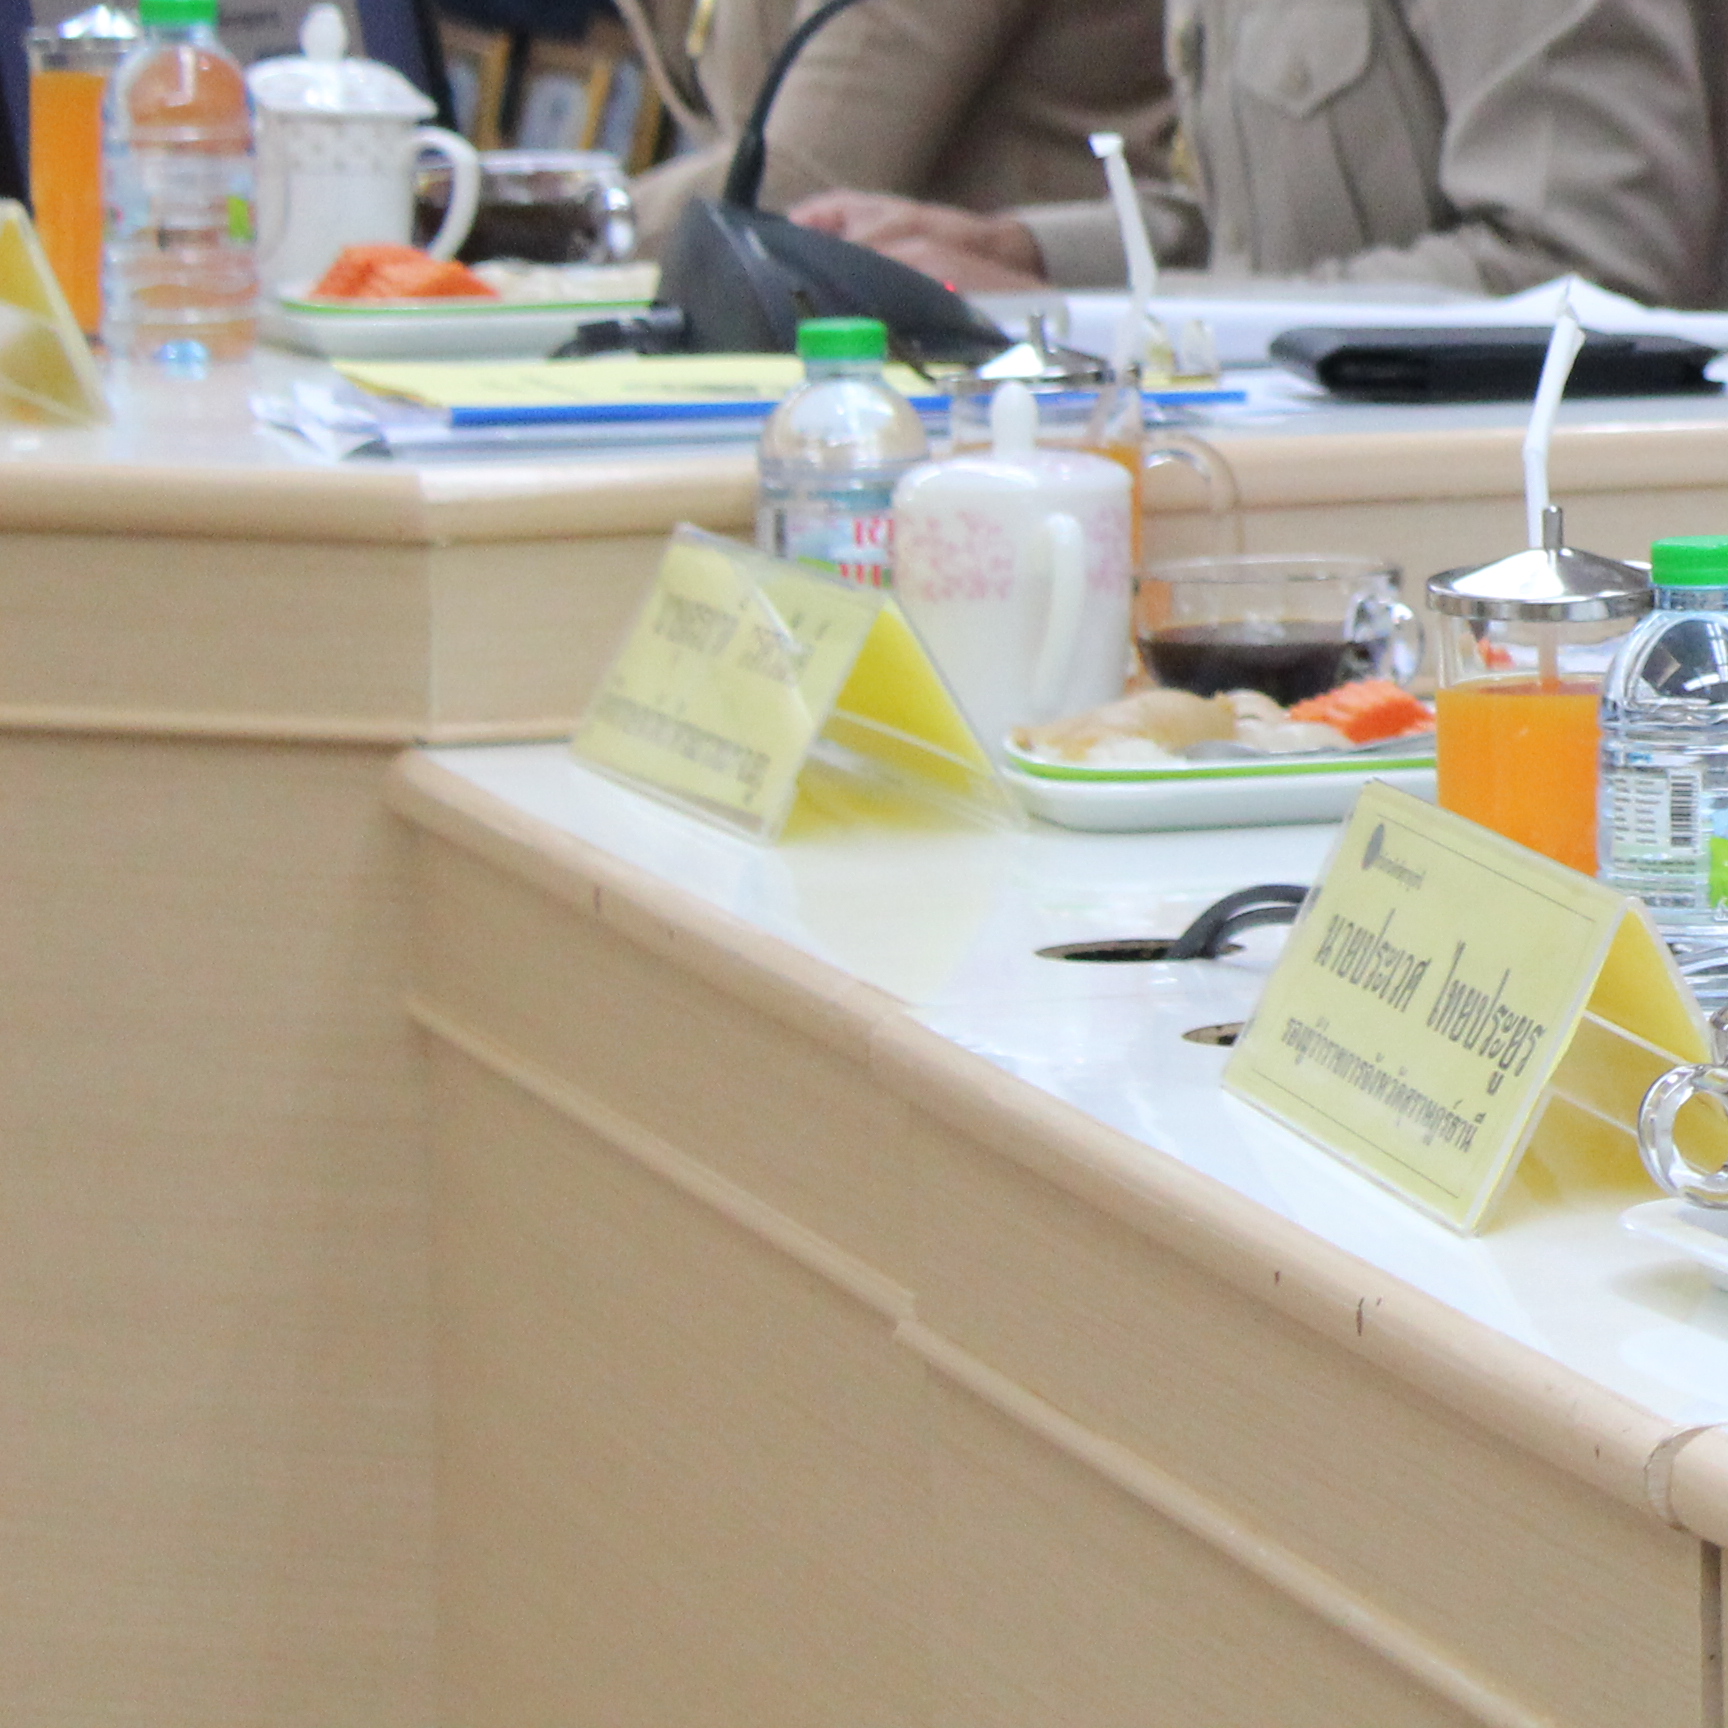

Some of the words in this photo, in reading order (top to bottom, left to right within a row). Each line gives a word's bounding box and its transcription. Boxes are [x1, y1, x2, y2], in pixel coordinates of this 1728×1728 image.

[1314, 908, 1432, 1013] นายประเวศ
[1426, 939, 1547, 1096] ไทยประยูร
